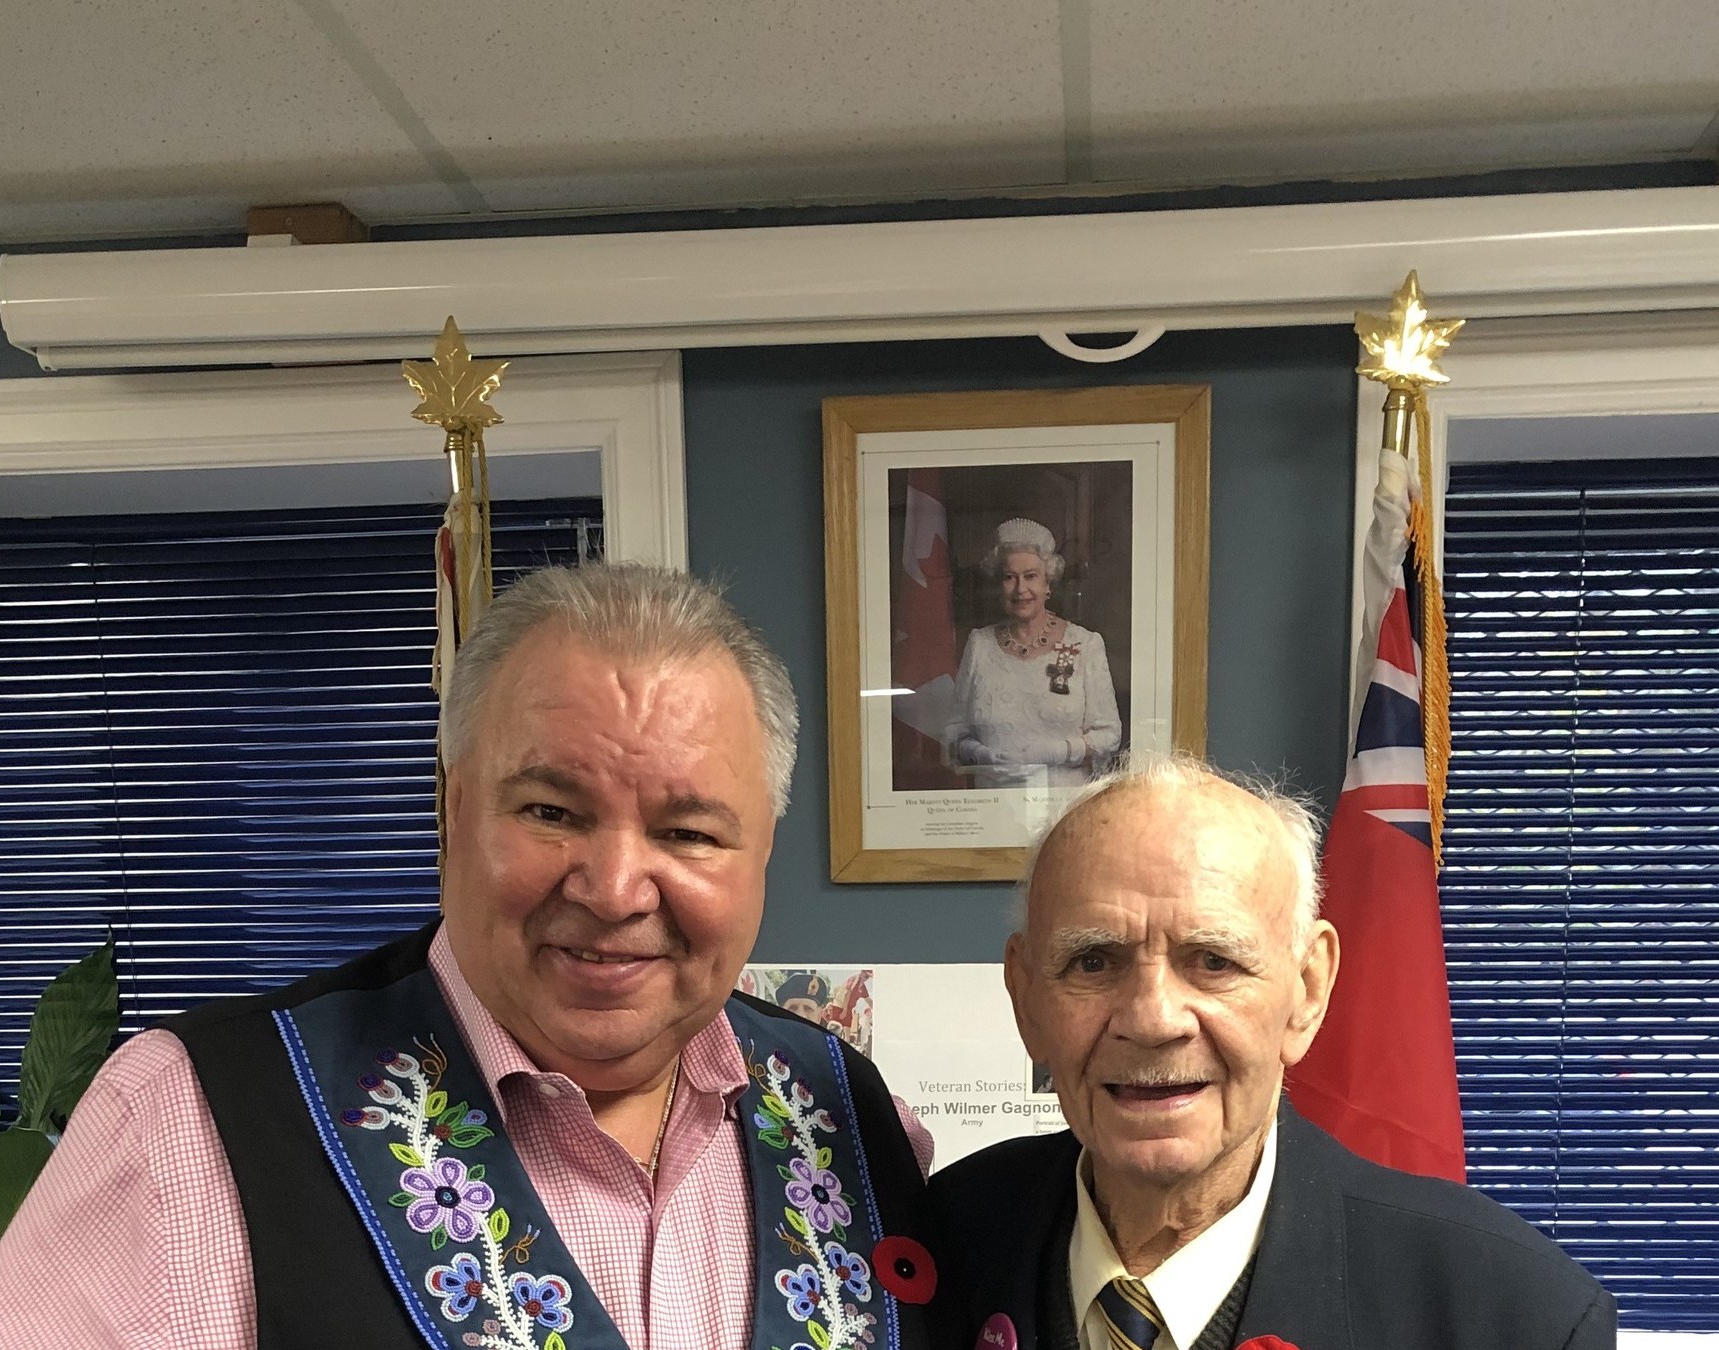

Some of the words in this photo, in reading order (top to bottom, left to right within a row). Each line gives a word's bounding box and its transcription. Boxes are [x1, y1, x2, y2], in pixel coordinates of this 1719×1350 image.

[919, 1080, 971, 1092] Veteran
[975, 1080, 1026, 1092] Stories:
[912, 1102, 939, 1118] eph
[944, 1102, 997, 1114] Wilmer
[1002, 1101, 1061, 1117] Gagnon
[961, 1119, 983, 1127] Army
